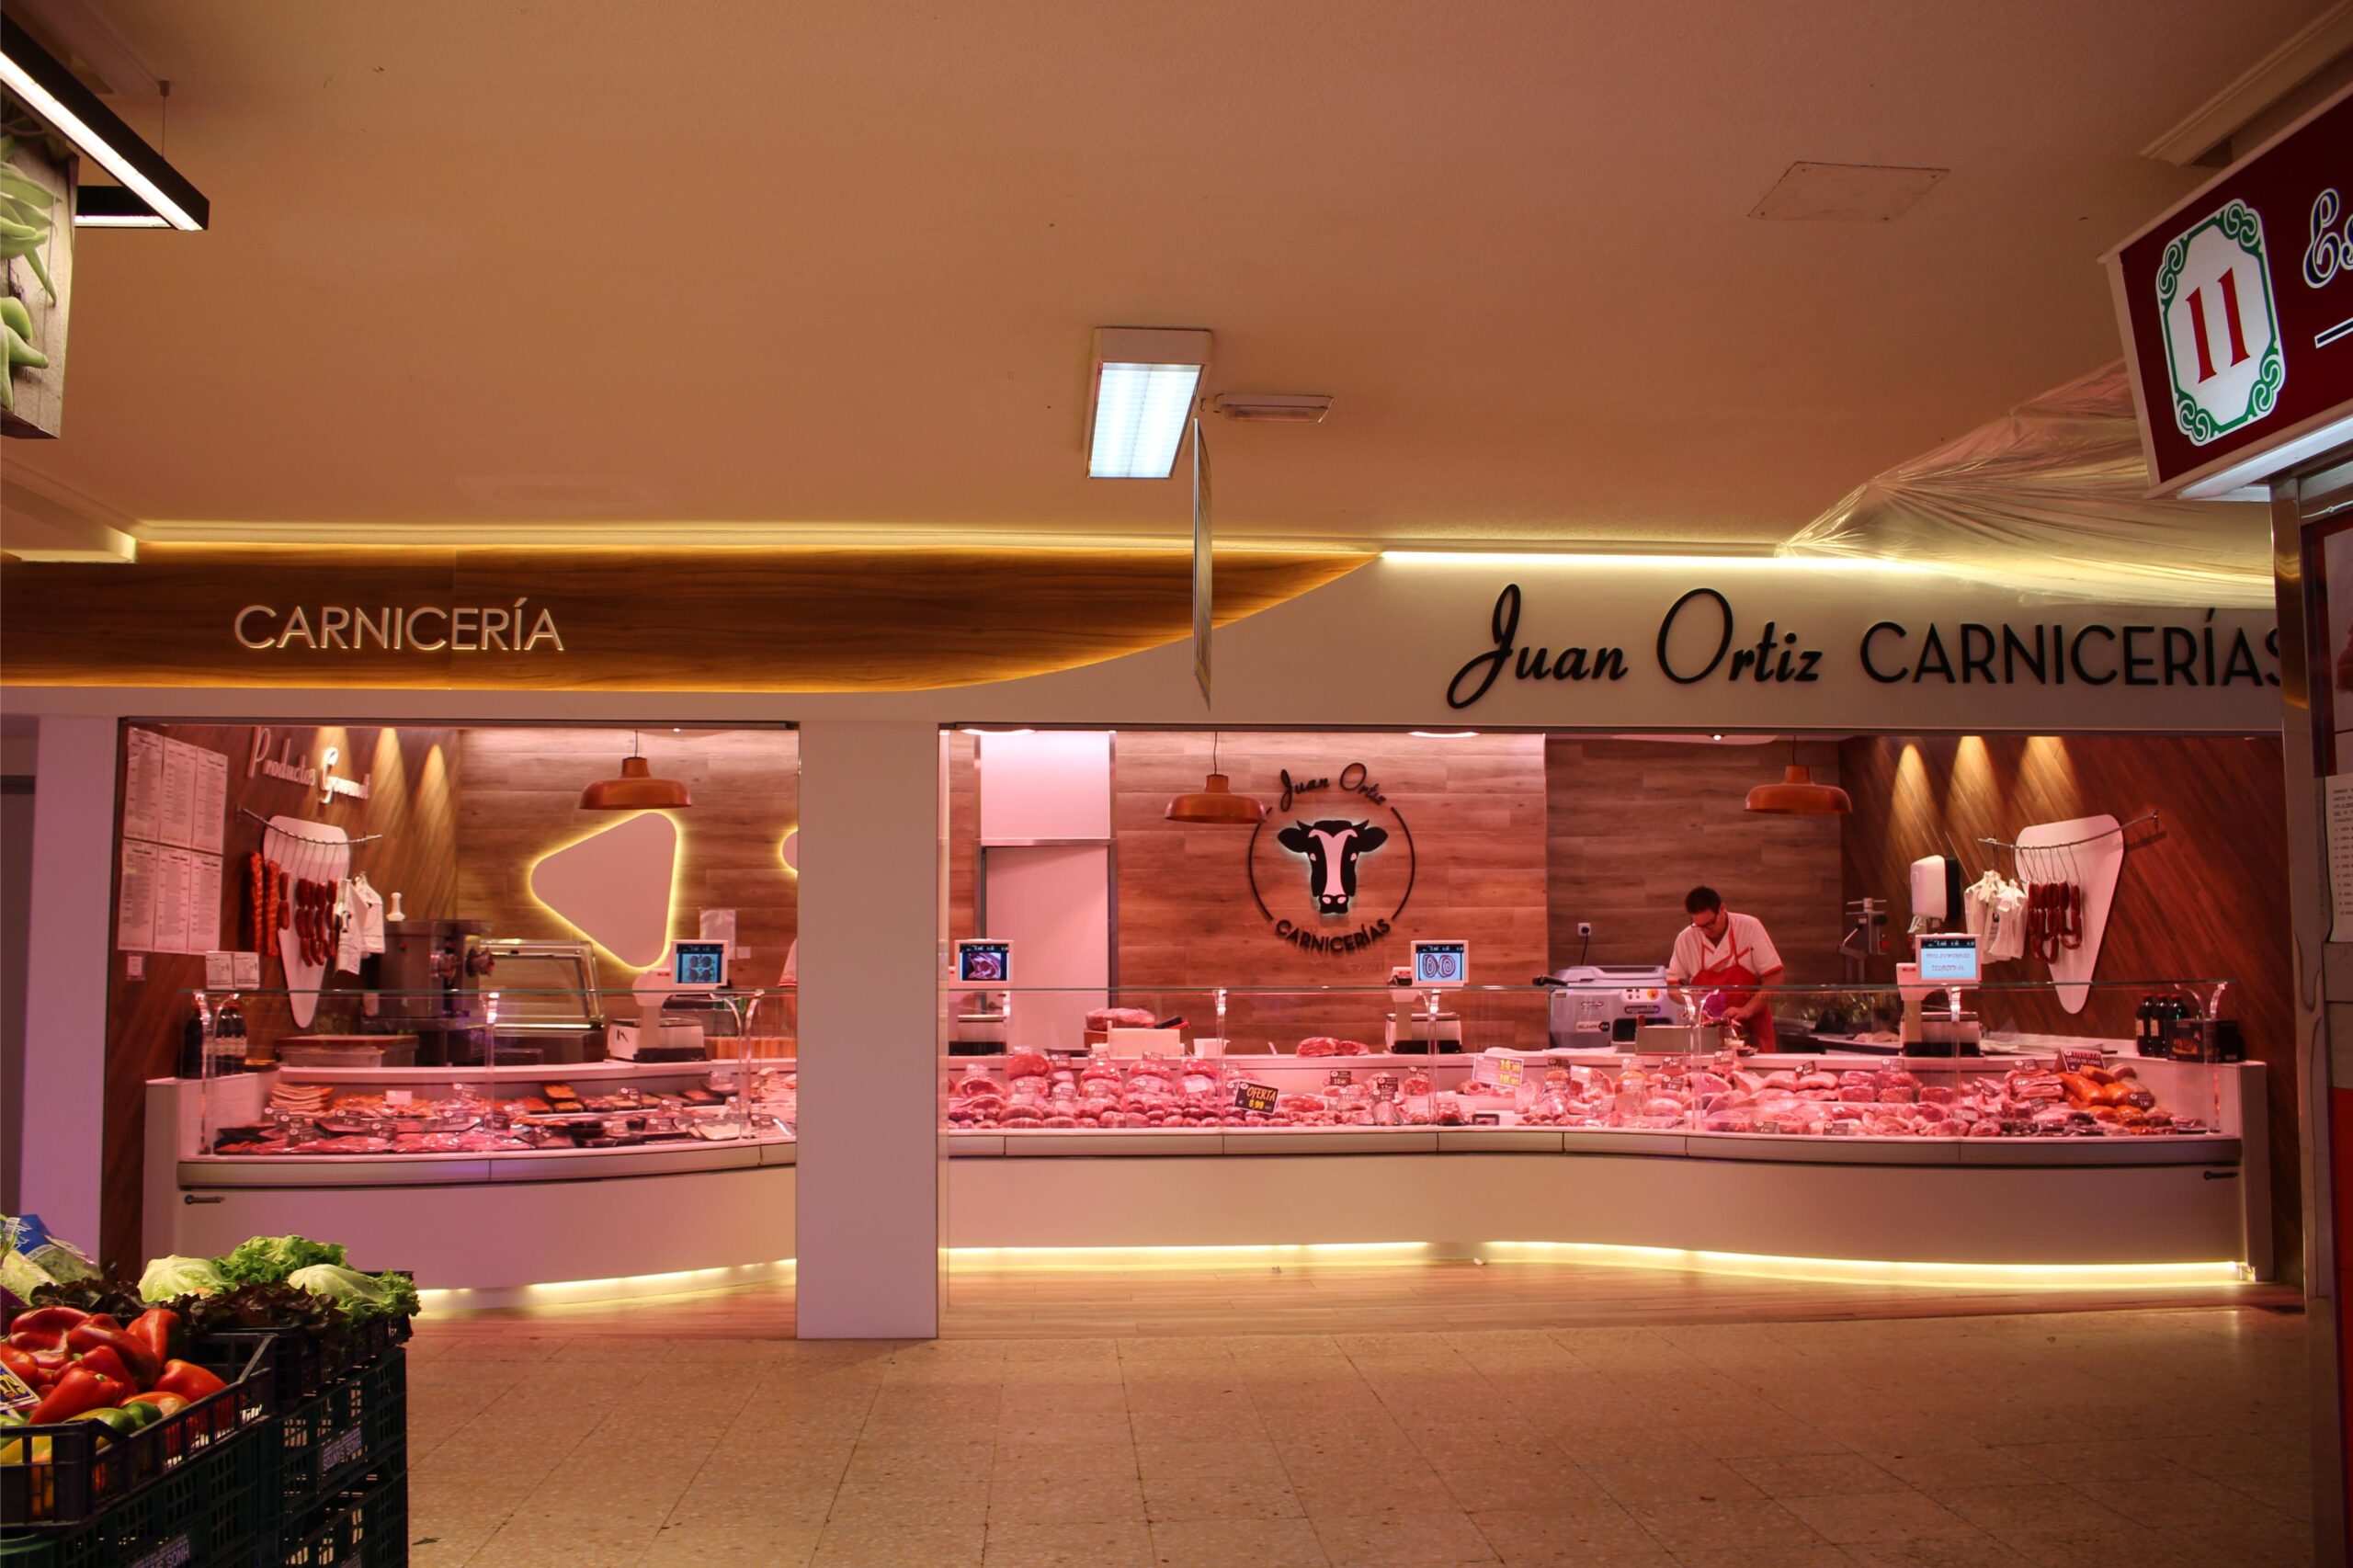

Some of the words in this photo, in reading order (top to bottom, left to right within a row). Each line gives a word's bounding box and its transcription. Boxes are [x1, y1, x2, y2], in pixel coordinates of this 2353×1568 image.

[2186, 267, 2250, 384] 11
[234, 597, 564, 652] CARNICERÍA
[1446, 583, 1628, 710] Juan
[1656, 587, 1823, 685] Ortiz
[247, 726, 316, 786] Productos
[1280, 768, 1330, 812] Juan
[1339, 762, 1387, 806] Ortiz
[1276, 919, 1391, 953] CARNICERÍAS
[1246, 1086, 1277, 1102] OFERTA
